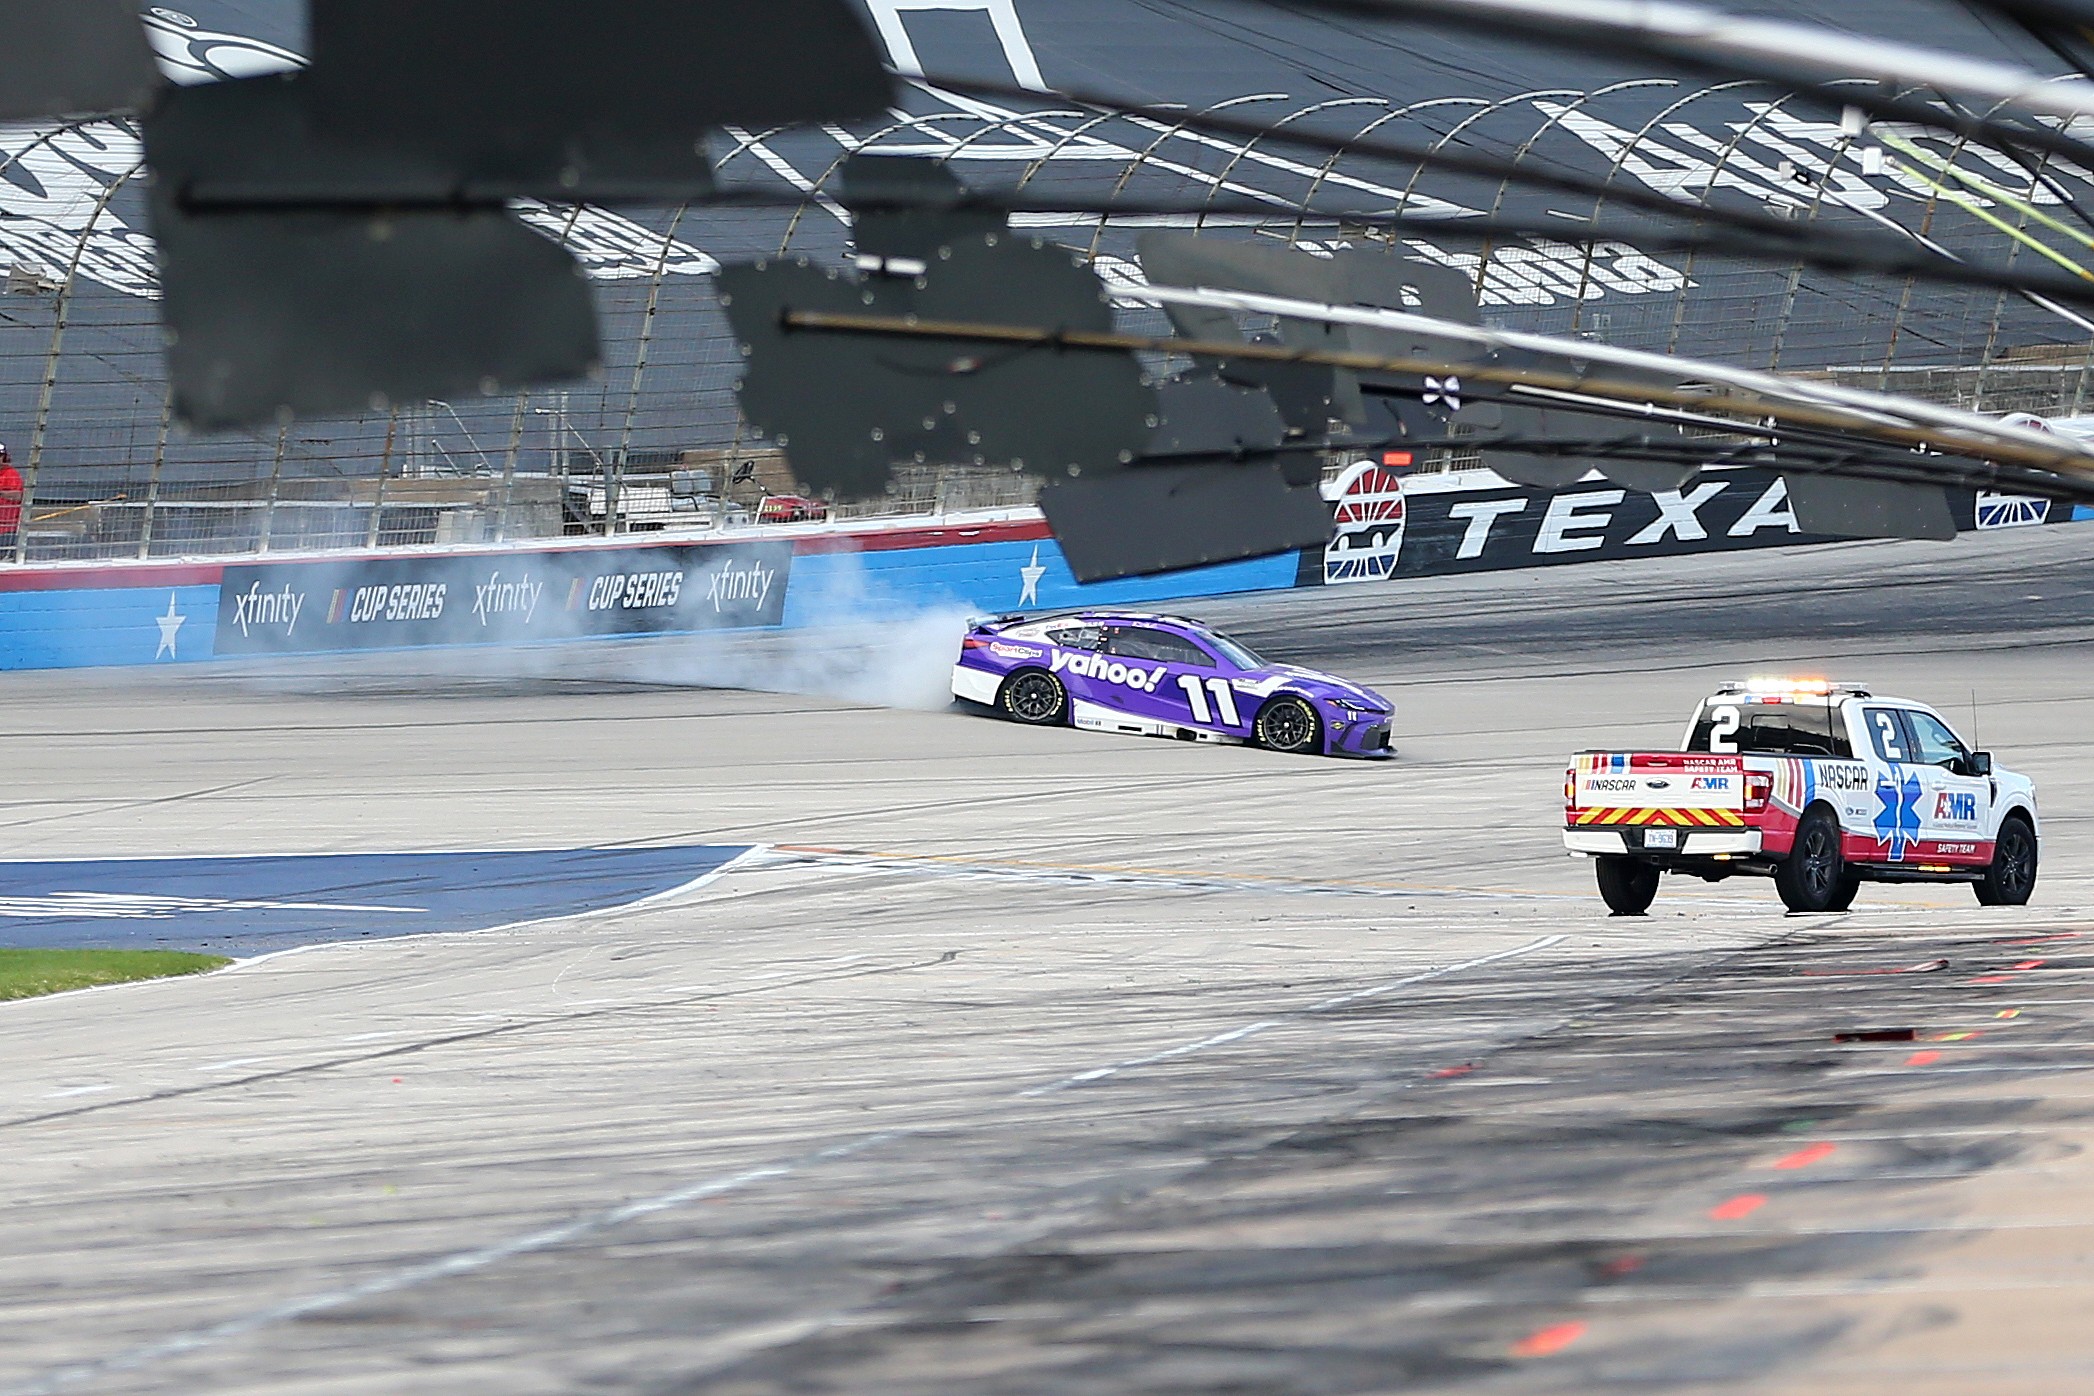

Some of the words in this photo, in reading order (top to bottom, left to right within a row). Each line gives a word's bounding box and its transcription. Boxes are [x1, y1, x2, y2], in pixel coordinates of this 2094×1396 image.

[1449, 476, 1802, 560] TEXA
[233, 580, 305, 638] xfinity
[351, 586, 390, 623] CUP
[386, 583, 447, 621] SERIES
[472, 571, 543, 626] xfinity
[589, 574, 626, 611] CUP
[622, 571, 683, 609] SERIES
[707, 558, 774, 613] xfinity
[1049, 649, 1168, 693] yahoo!
[1176, 674, 1241, 726] 11
[1347, 710, 1357, 721] 11
[1710, 706, 1740, 753] 2
[1874, 712, 1902, 758] 2
[1594, 779, 1636, 791] NASCAR
[1690, 777, 1729, 790] AMR
[1818, 764, 1868, 790] NASCAR
[1934, 792, 1976, 820] AMR
[1937, 843, 1959, 853] SAFETY
[1959, 843, 1975, 853] TEAM
